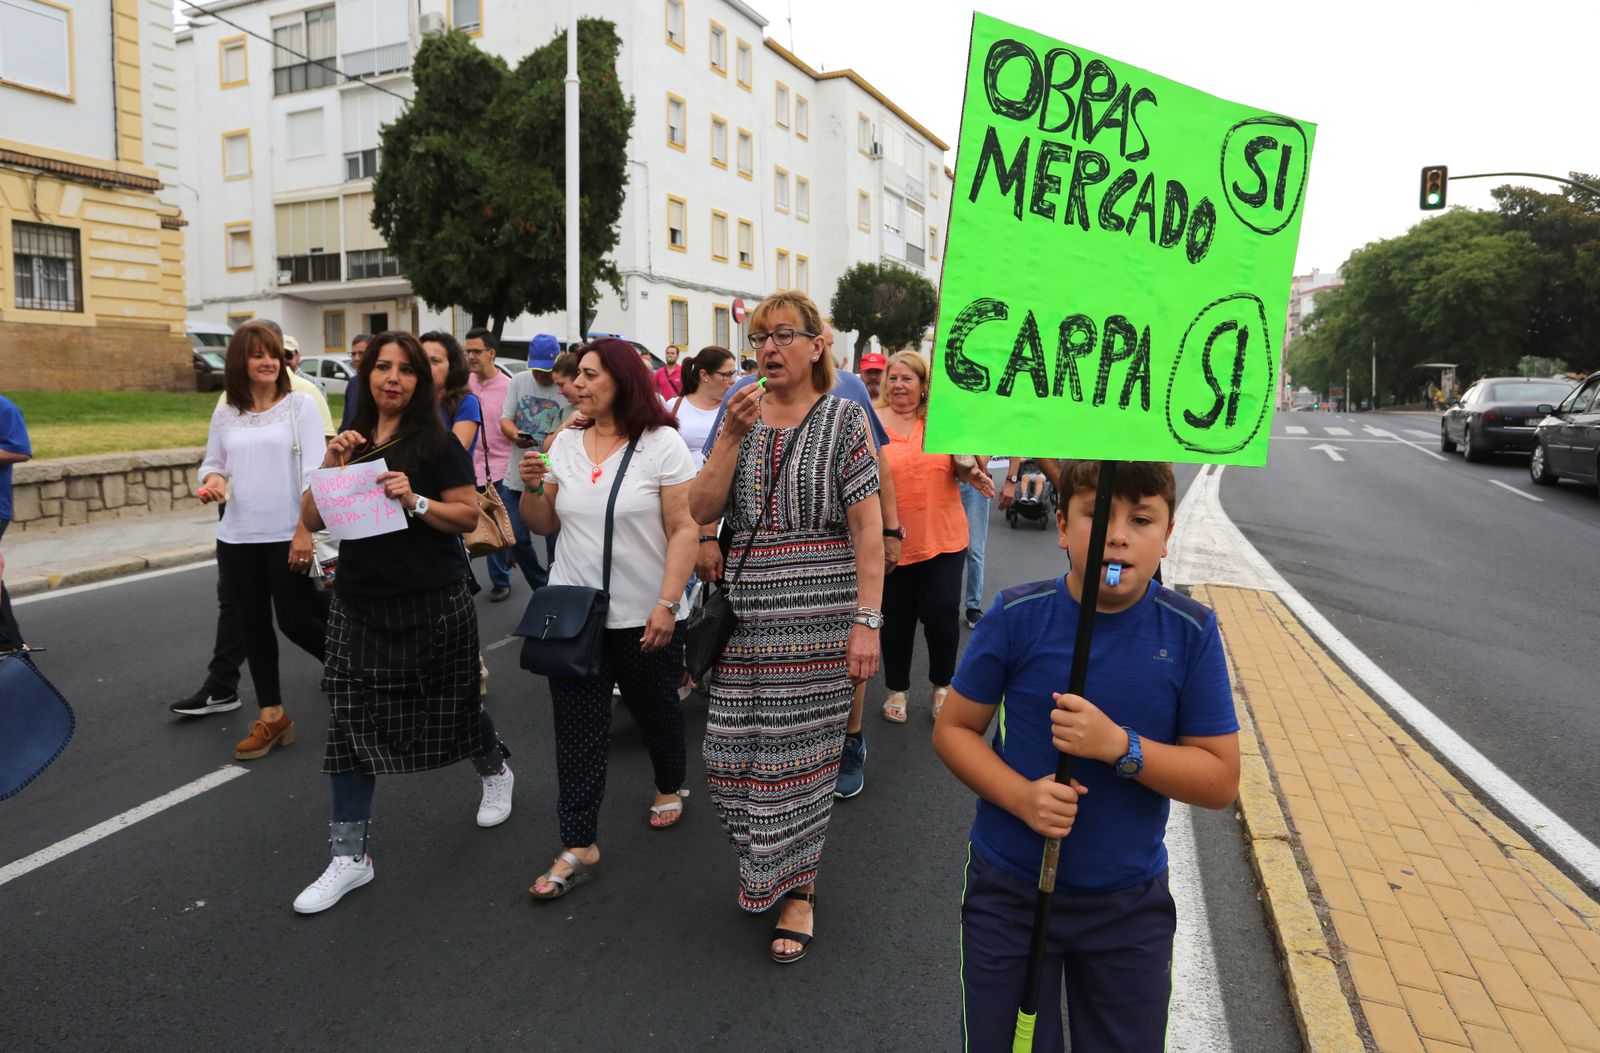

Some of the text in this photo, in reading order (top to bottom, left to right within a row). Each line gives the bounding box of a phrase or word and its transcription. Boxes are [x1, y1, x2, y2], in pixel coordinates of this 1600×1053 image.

[984, 39, 1158, 162] OBRAS
[969, 125, 1216, 264] MERCADO
[1233, 136, 1292, 211] SI
[945, 298, 1248, 429] CARPA SI
